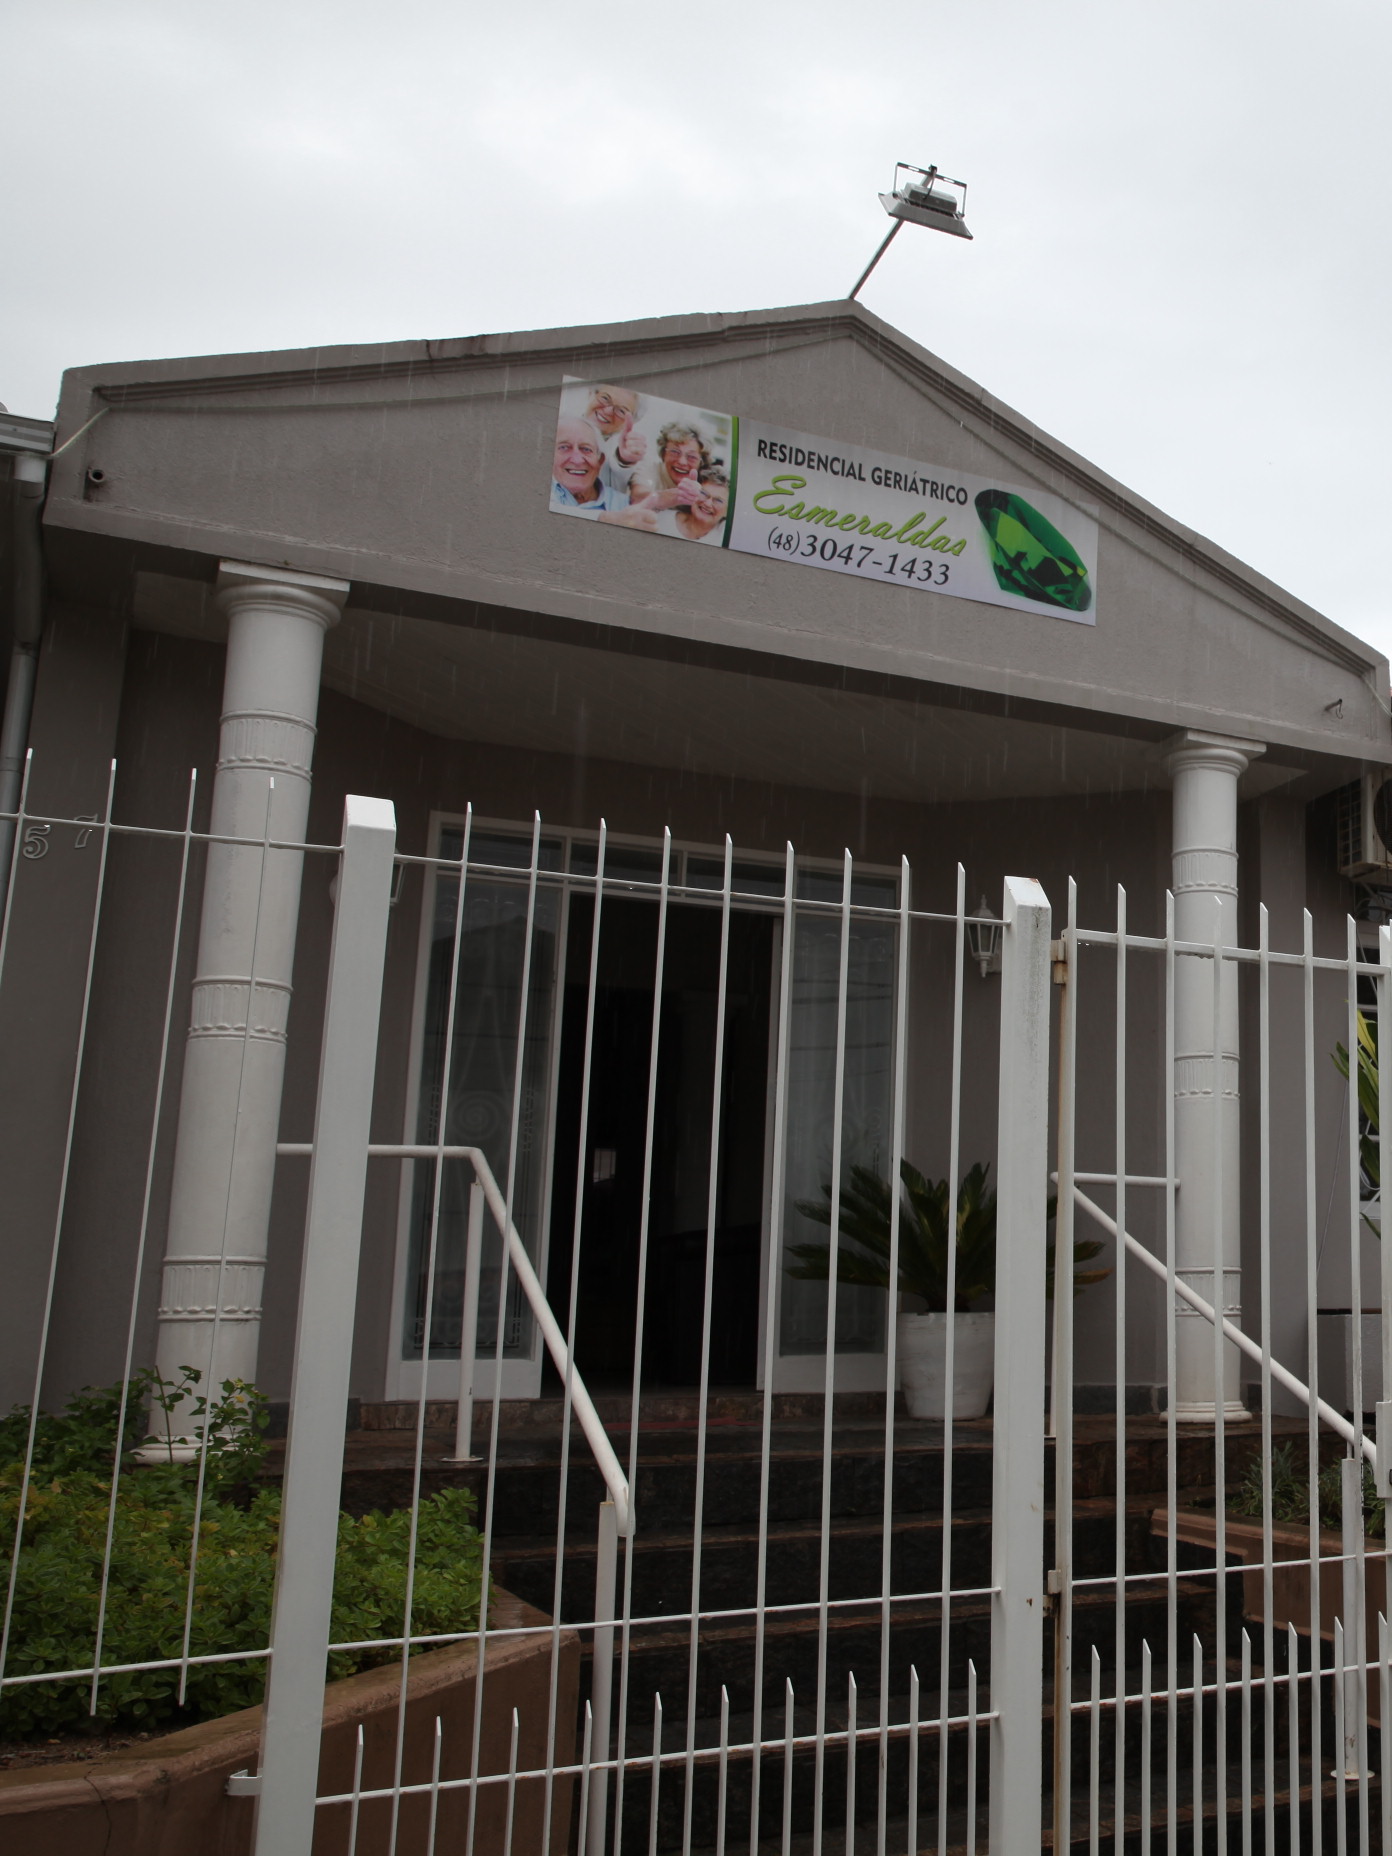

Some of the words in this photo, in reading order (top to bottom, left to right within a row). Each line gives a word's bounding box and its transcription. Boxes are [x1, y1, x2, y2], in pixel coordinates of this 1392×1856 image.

[757, 439, 866, 482] RESIDENCIAL
[871, 468, 968, 506] GERIÁTRICO
[753, 475, 968, 557] Esmeraldas
